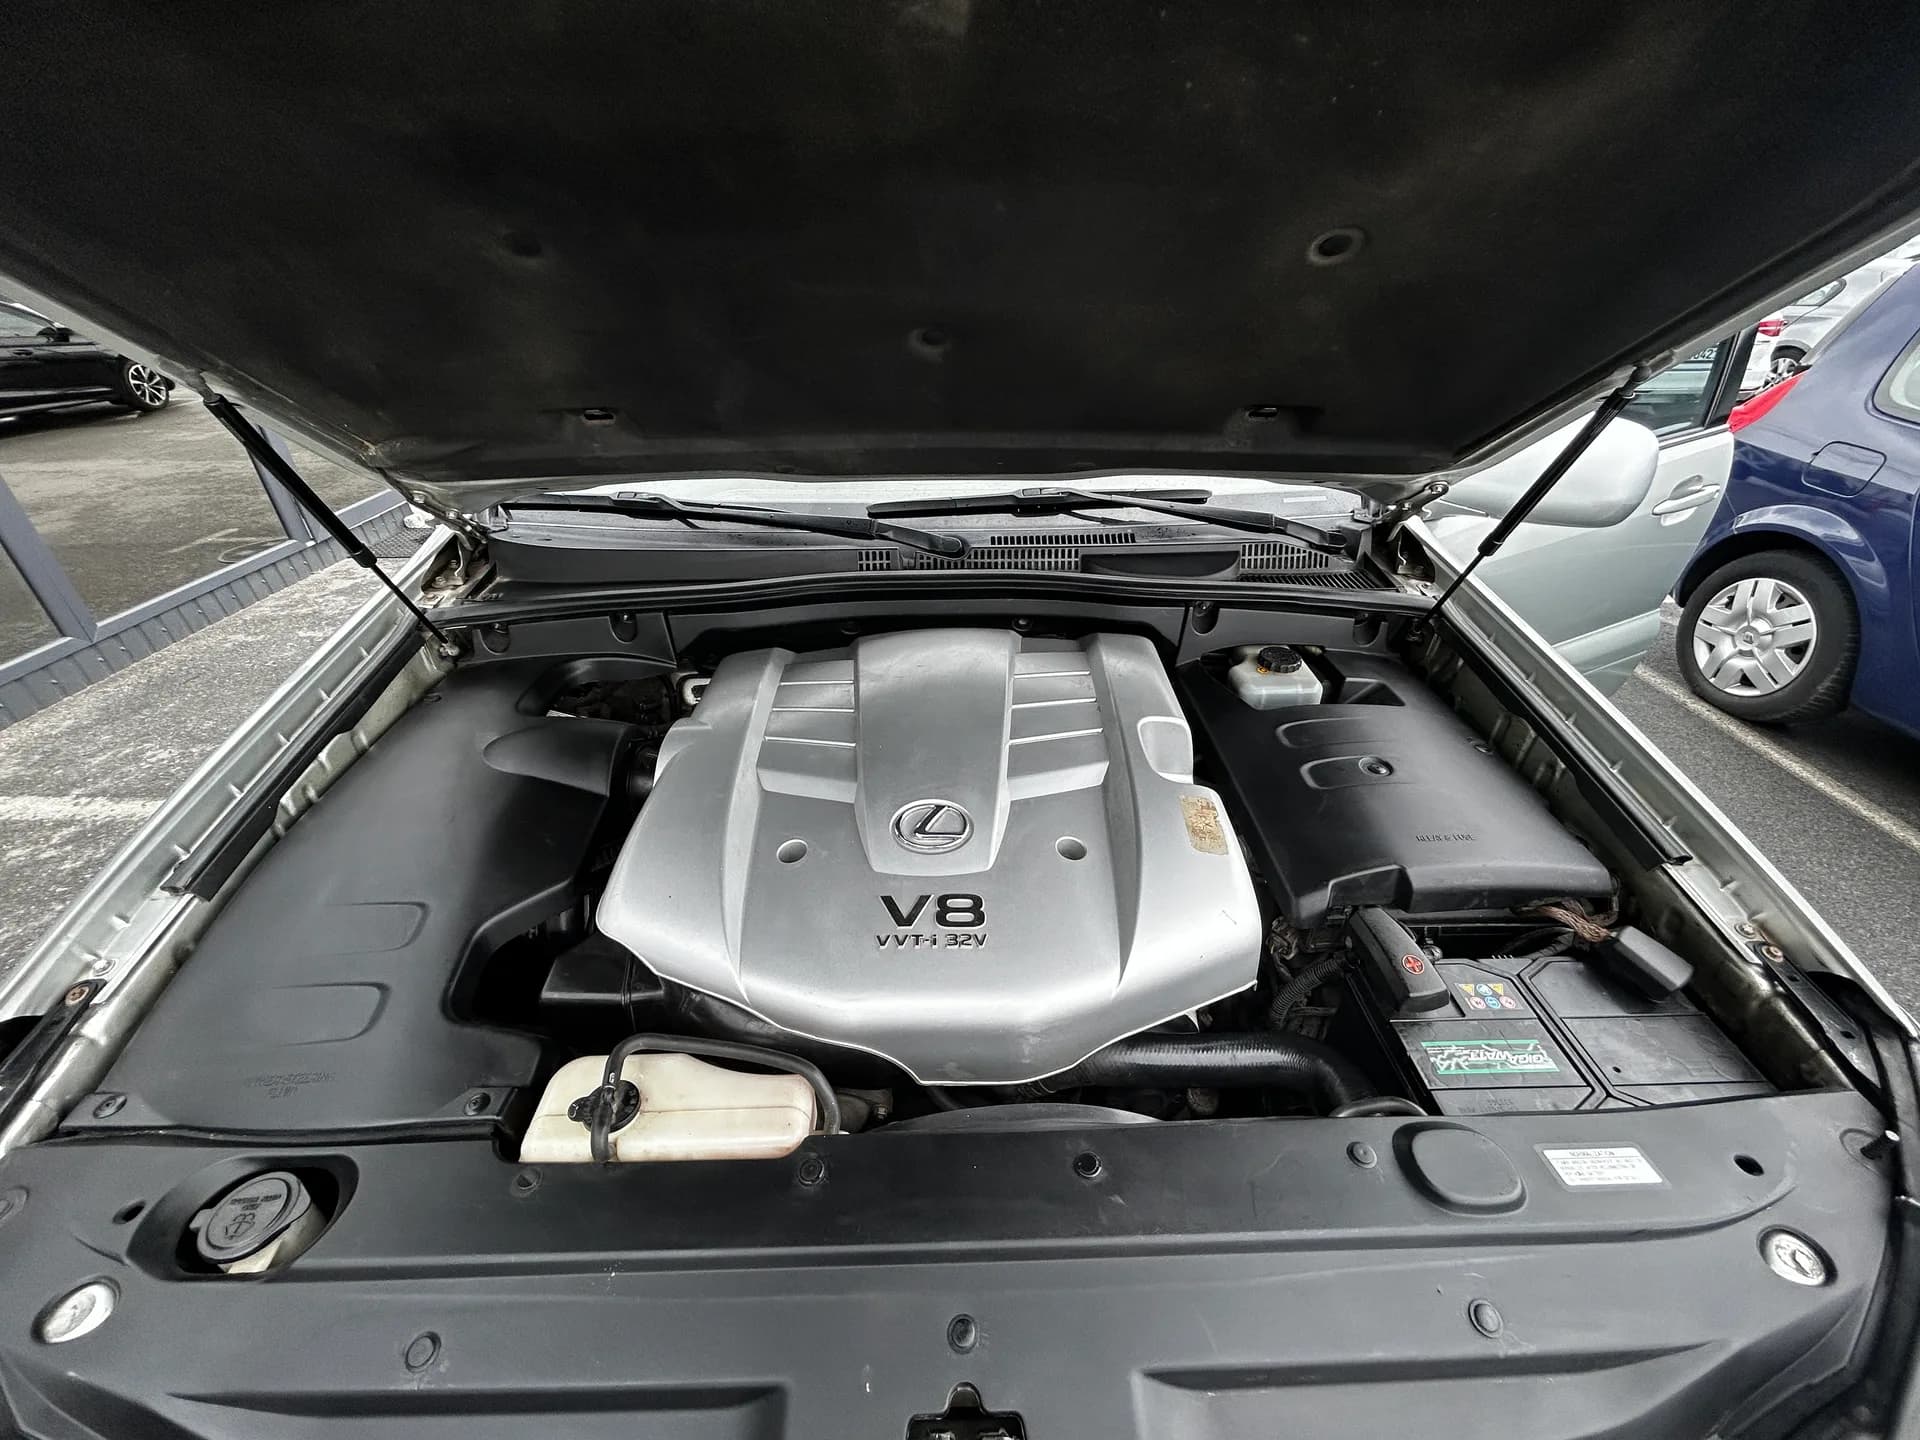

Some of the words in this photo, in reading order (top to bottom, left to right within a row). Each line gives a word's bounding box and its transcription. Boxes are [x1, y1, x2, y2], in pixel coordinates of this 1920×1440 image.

[880, 893, 986, 929] V8
[876, 934, 938, 948] VVT-i
[944, 934, 988, 948] 32V
[1467, 1049, 1545, 1066] GIGAWATT
